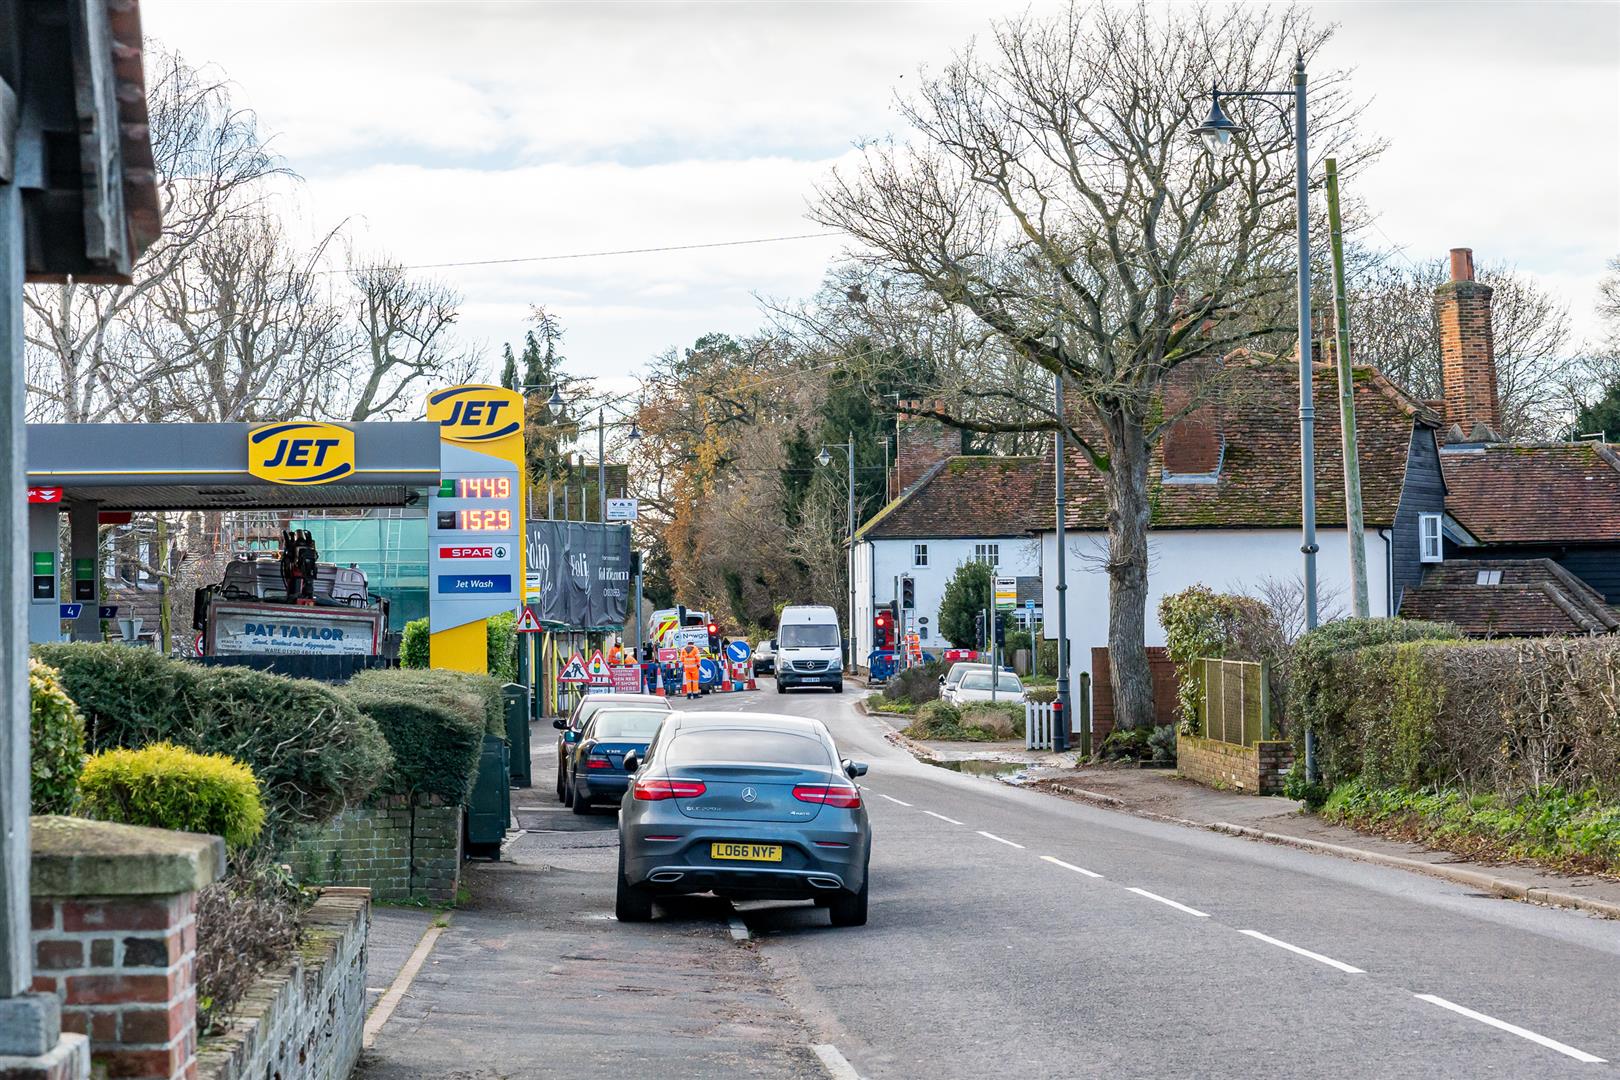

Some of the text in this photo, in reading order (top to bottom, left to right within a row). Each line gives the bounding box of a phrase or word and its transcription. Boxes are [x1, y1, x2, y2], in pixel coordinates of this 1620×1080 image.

[441, 400, 509, 426] JET
[263, 439, 340, 467] JET
[452, 549, 492, 557] SPAR
[456, 580, 494, 588] Jet Wash
[67, 606, 74, 615] 4
[105, 609, 111, 617] 2
[245, 623, 344, 641] PAT TAYLOR
[716, 846, 777, 859] LO66 NYF
